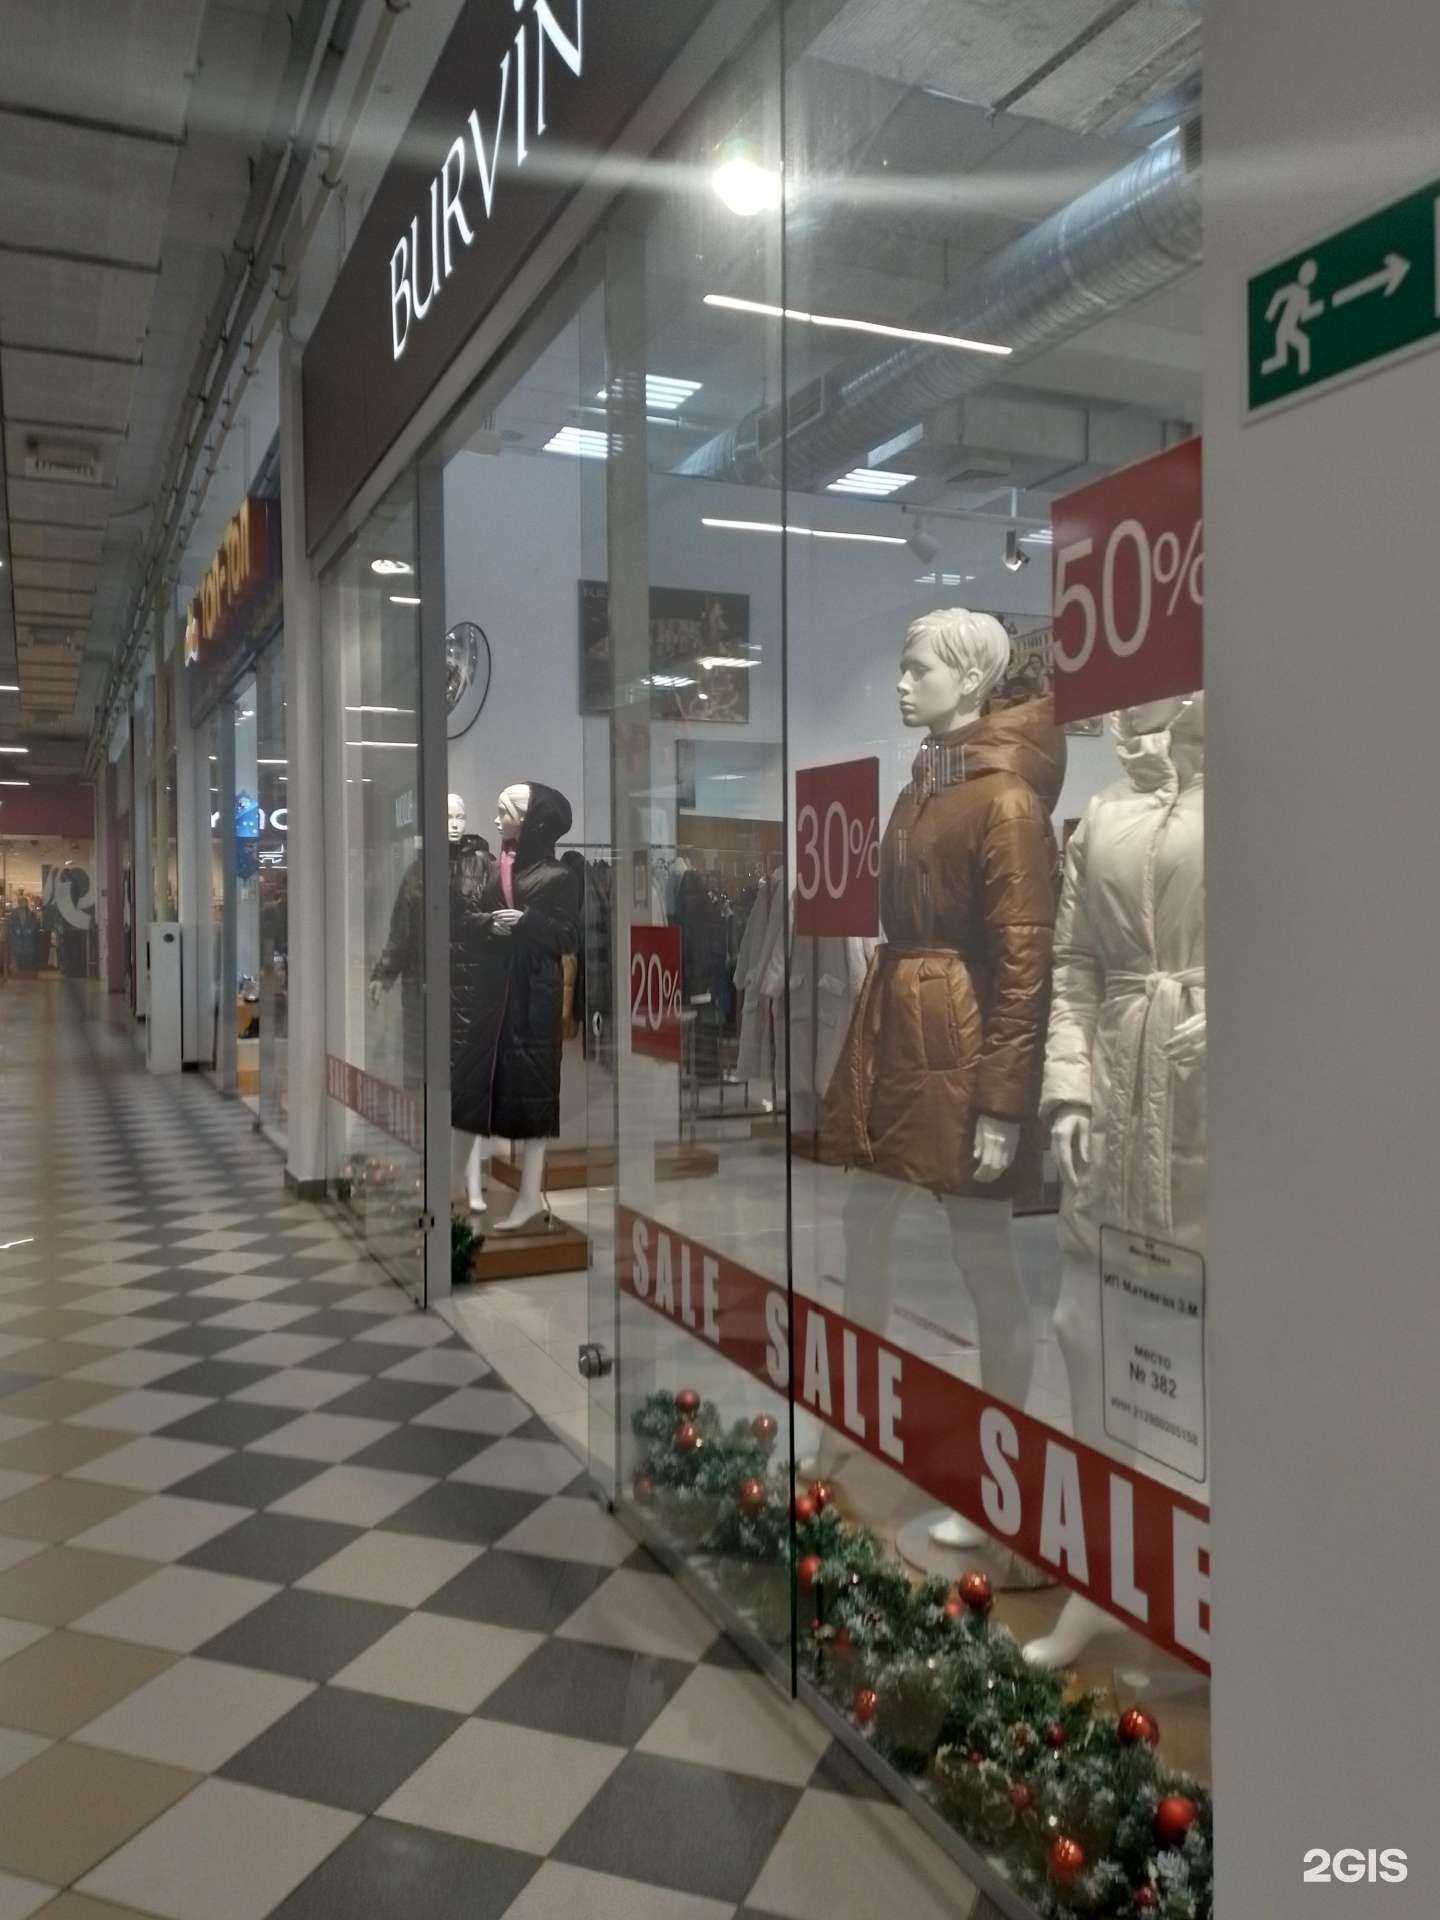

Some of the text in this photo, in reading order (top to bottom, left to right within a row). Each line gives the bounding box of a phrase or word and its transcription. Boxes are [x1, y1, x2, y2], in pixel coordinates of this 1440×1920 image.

[1052, 518, 1205, 673] 50%
[797, 801, 880, 900] 30%
[631, 952, 682, 1031] 20%
[1151, 1371, 1177, 1399] 382
[632, 1217, 1209, 1664] SALE SALE SALE
